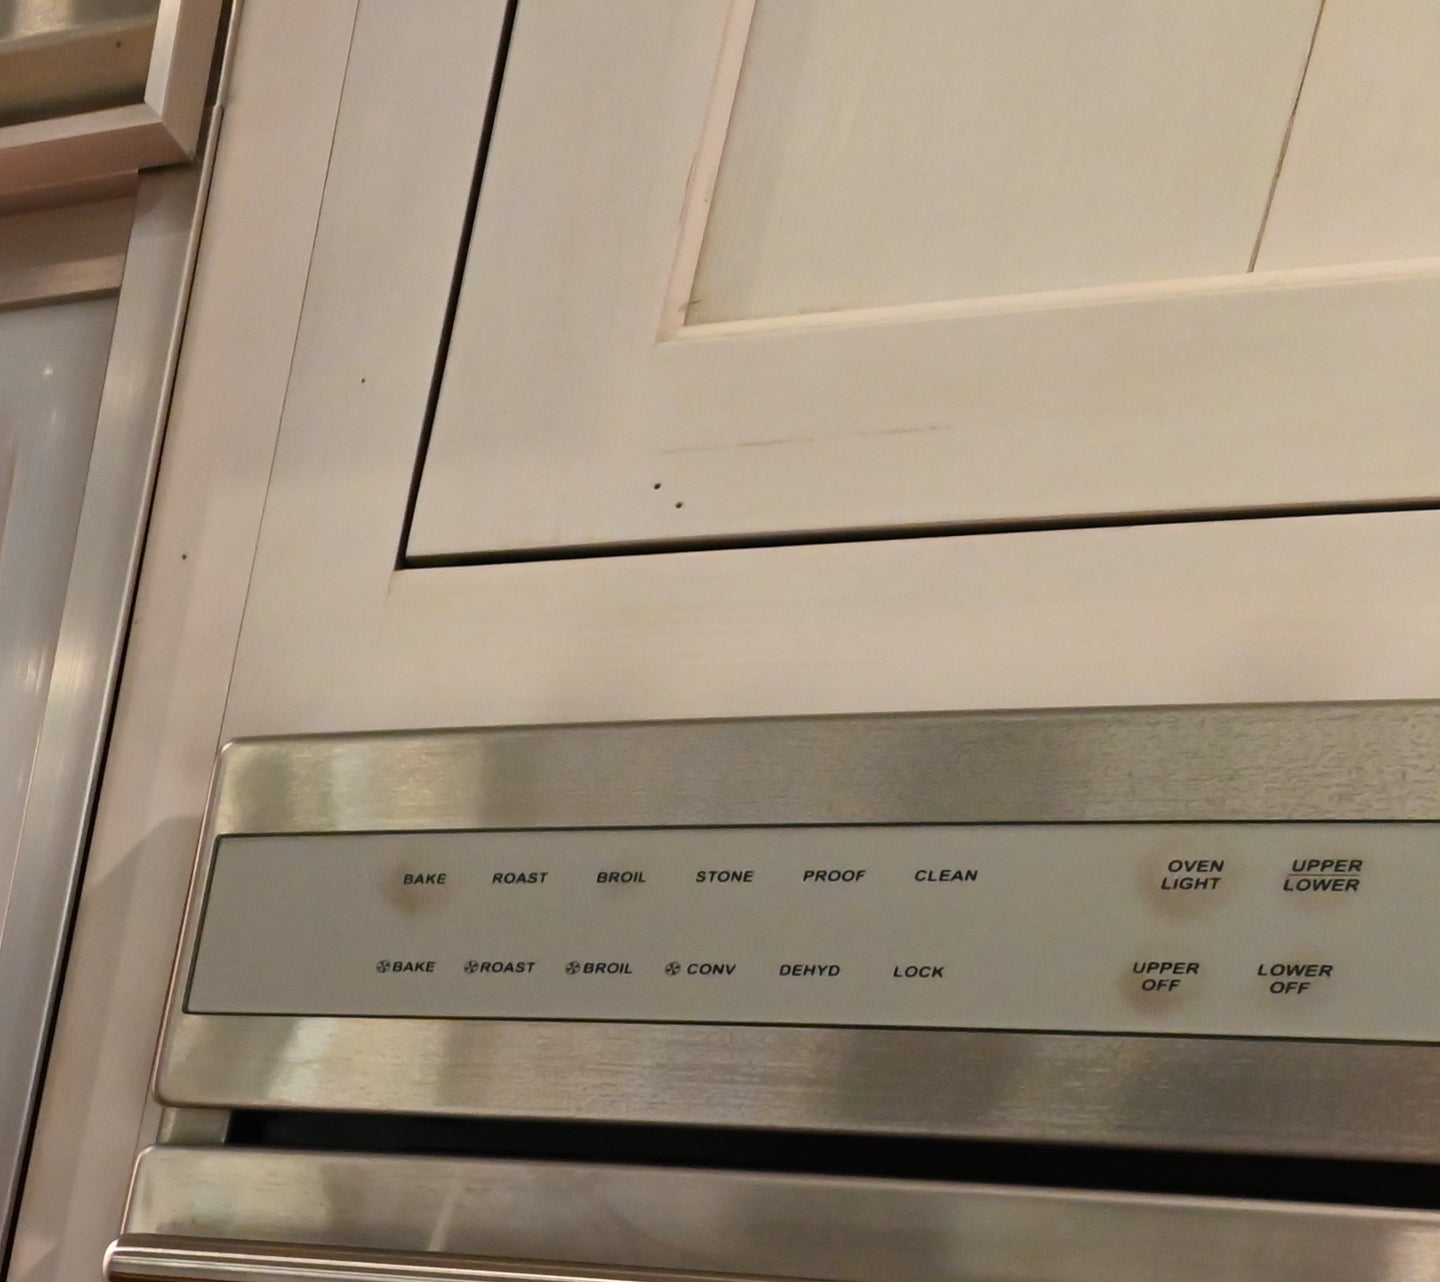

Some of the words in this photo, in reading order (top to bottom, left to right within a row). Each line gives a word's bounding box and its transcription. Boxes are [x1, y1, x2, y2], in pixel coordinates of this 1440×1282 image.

[1167, 859, 1225, 872] OVEN
[1291, 859, 1364, 872] UPPER
[402, 873, 447, 885] BAKE
[492, 872, 548, 884] ROAST
[596, 871, 647, 884] BROIL
[695, 870, 754, 883] STONE
[803, 870, 866, 882] PROOF
[914, 870, 978, 882] CLEAN
[1161, 878, 1221, 891] LIGHT
[1283, 879, 1360, 892] LOWER
[392, 961, 436, 973] BAKE
[480, 962, 536, 973] ROAST
[583, 963, 633, 974] BROIL
[686, 963, 736, 975] CONV
[780, 965, 840, 977] DEHYD
[893, 965, 945, 978] LOCK
[1132, 961, 1200, 975] UPPER
[1258, 963, 1333, 977] LOWER
[1142, 979, 1182, 992] OFF
[1269, 981, 1311, 994] OFF
